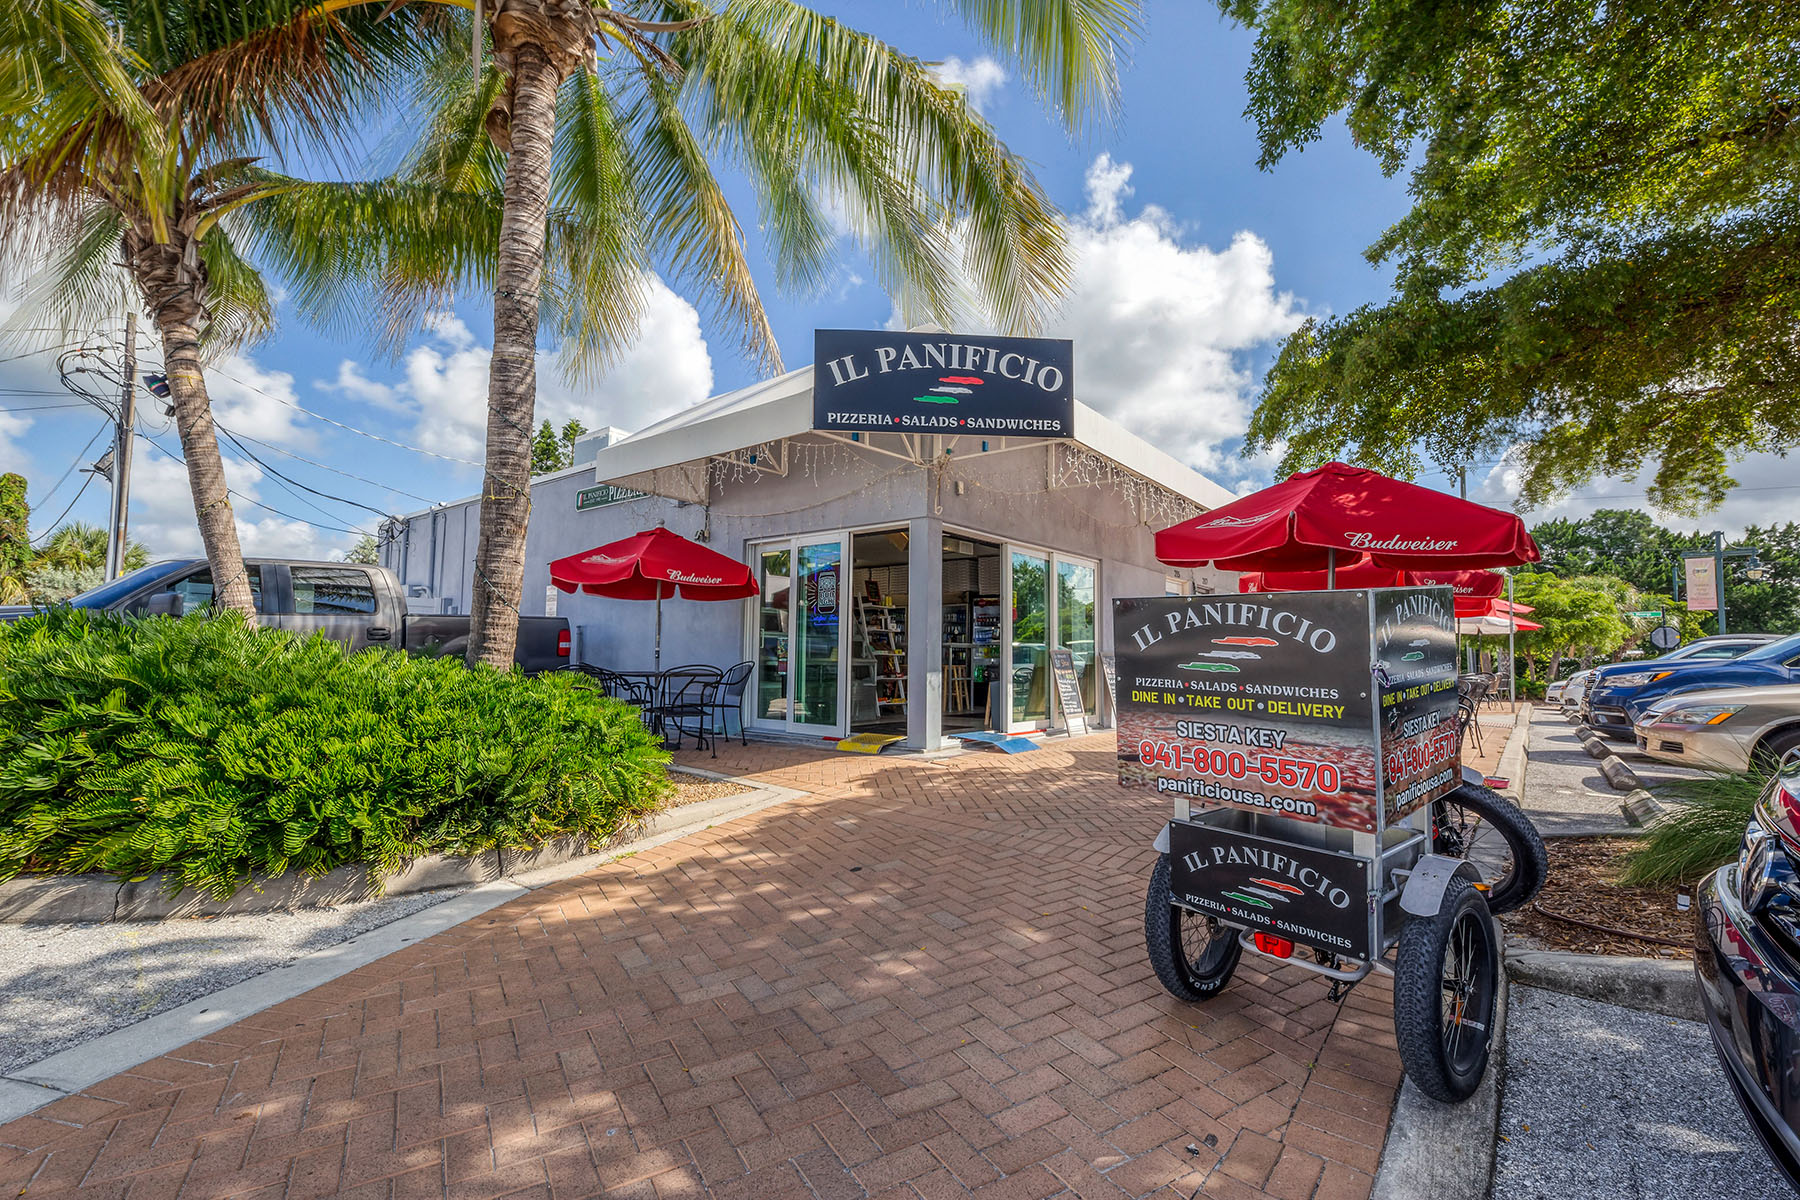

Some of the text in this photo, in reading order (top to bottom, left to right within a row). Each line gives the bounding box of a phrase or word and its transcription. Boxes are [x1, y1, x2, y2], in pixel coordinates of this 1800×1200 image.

[826, 343, 1063, 392] IL PANIFICIO
[827, 412, 1061, 431] PIZZERIA SALADS SANDWICHES
[1344, 531, 1458, 551] Budweiser
[666, 569, 722, 584] Budweiser
[1131, 602, 1336, 653] IL PANIFICIO
[1381, 595, 1451, 648] IL PANIFICIO
[1406, 669, 1424, 681] SALADS
[1426, 662, 1453, 675] SANDWICHES
[1135, 677, 1339, 699] PIZZERIA SALADS SANDWICHES
[1382, 692, 1395, 707] DINE
[1396, 689, 1403, 703] IN
[1406, 686, 1420, 700] TAKE
[1421, 684, 1430, 697] OUT
[1131, 690, 1345, 720] DINE IN TAKE OUT DELIVERY
[1176, 721, 1286, 749] SIESTA KEY
[1403, 710, 1441, 738] SIESTA KEY
[1139, 740, 1341, 794] 941-800-5570
[1388, 730, 1456, 785] 941-800-5570
[1157, 777, 1316, 816] panificiousa.com
[1396, 768, 1453, 811] panificiousa.com
[1182, 846, 1350, 909] IL PANIFICIO
[1185, 893, 1352, 949] PIZZERIA SALADS SANDWICHES
[1189, 976, 1220, 990] KENDA
